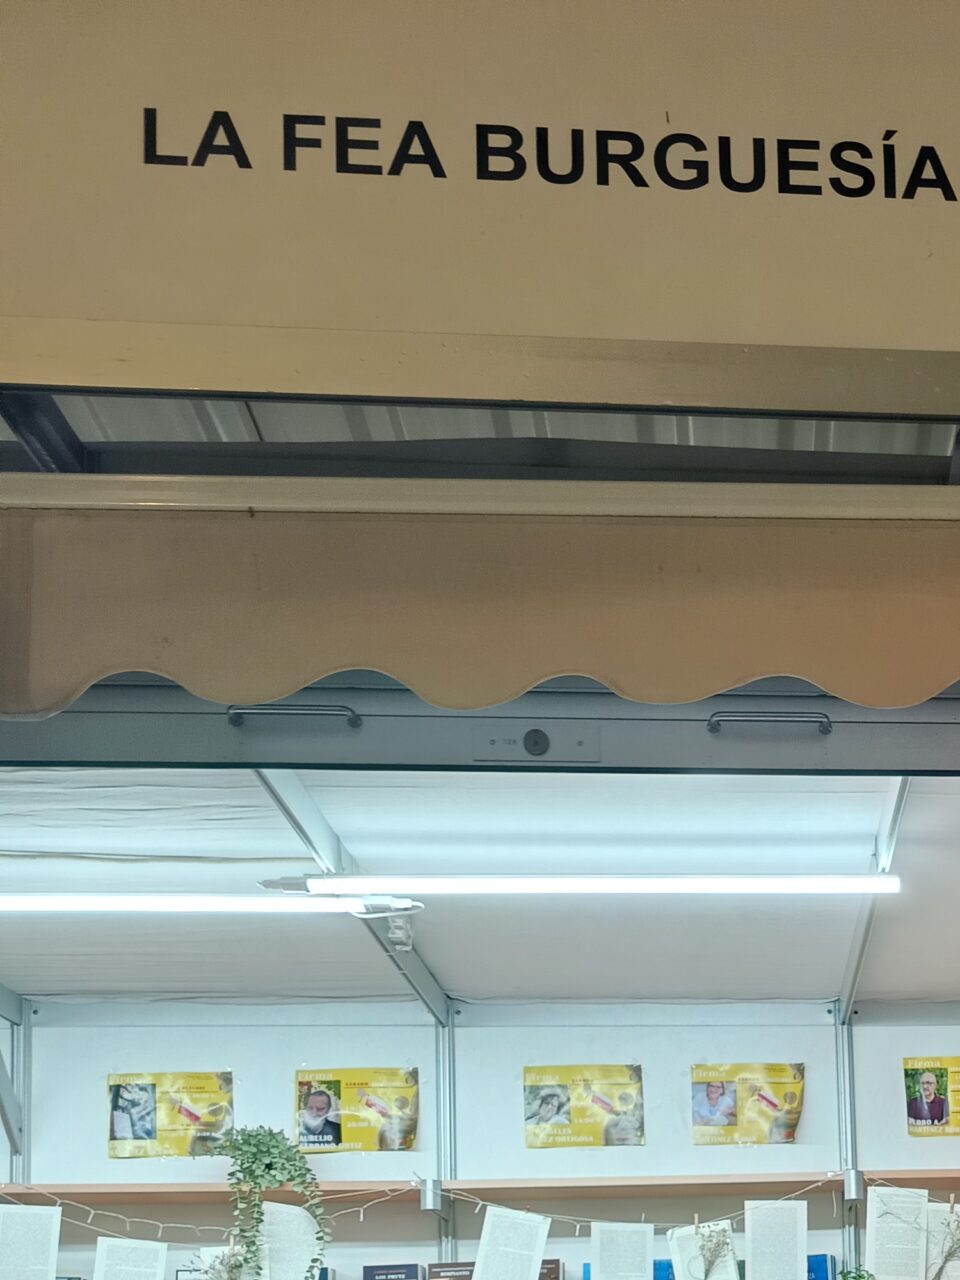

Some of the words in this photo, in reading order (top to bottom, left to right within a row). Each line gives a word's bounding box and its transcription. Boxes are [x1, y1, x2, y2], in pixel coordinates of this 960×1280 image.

[143, 106, 253, 169] LA
[281, 113, 448, 178] FEA
[475, 123, 959, 201] BURGUESÍA
